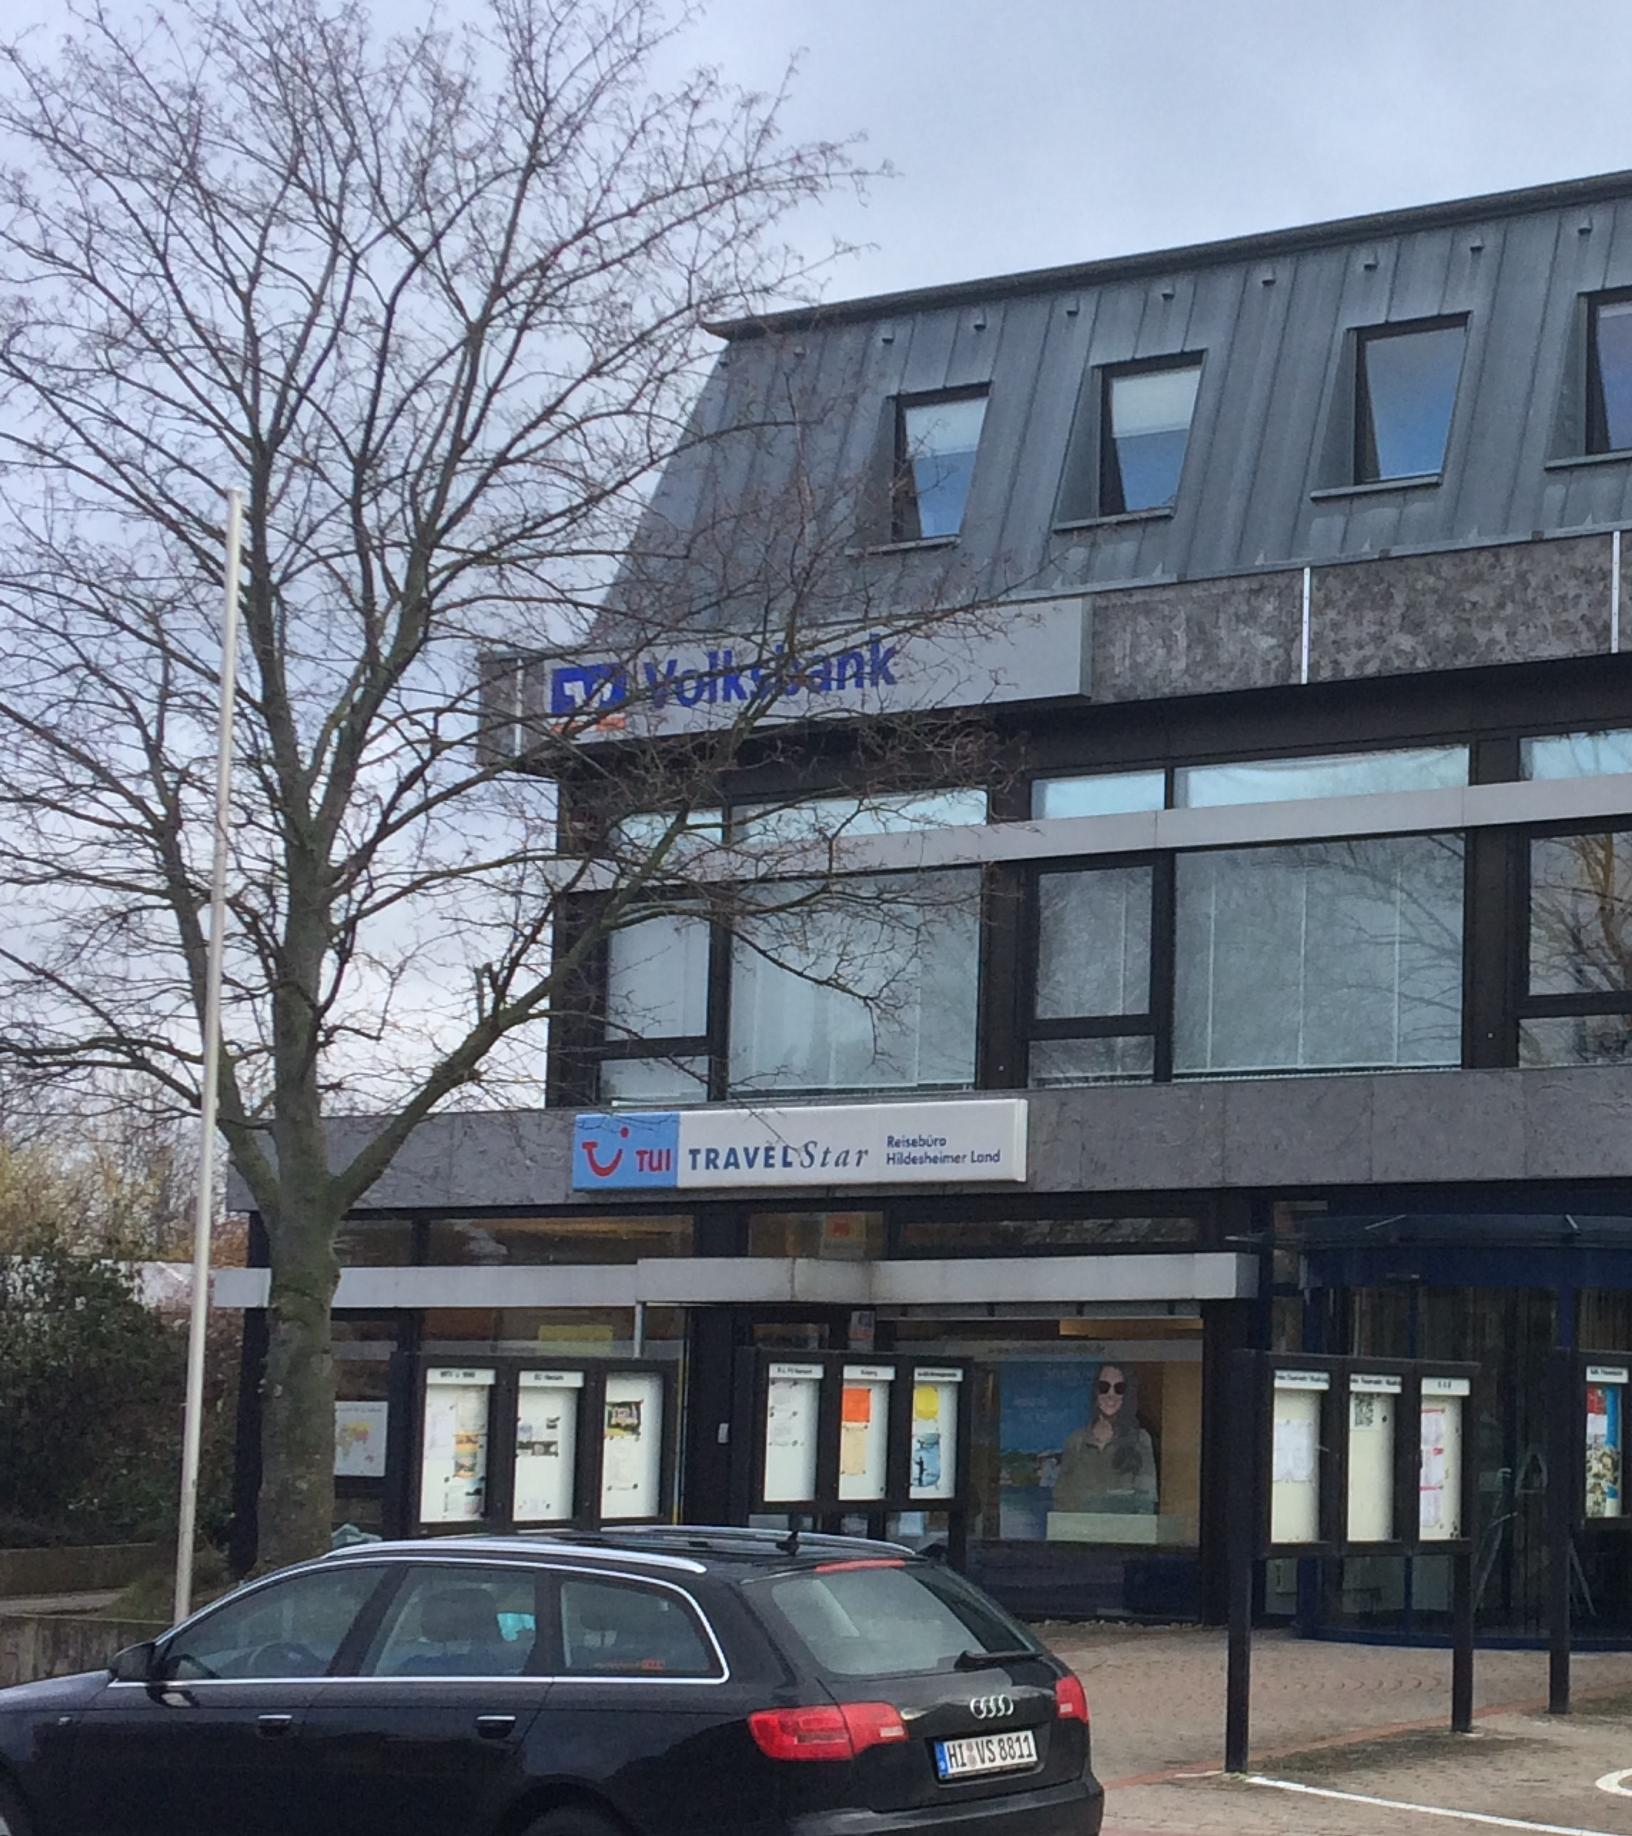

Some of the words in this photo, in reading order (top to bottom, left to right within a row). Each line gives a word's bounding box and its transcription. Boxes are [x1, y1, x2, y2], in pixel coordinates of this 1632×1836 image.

[886, 1134, 947, 1148] Reisebüro
[635, 1148, 671, 1172] TUI
[886, 1150, 967, 1165] Hildesheimer
[970, 1148, 1001, 1163] Land
[946, 1743, 967, 1769] HI
[975, 1739, 997, 1765] VS
[998, 1734, 1034, 1761] 8811
